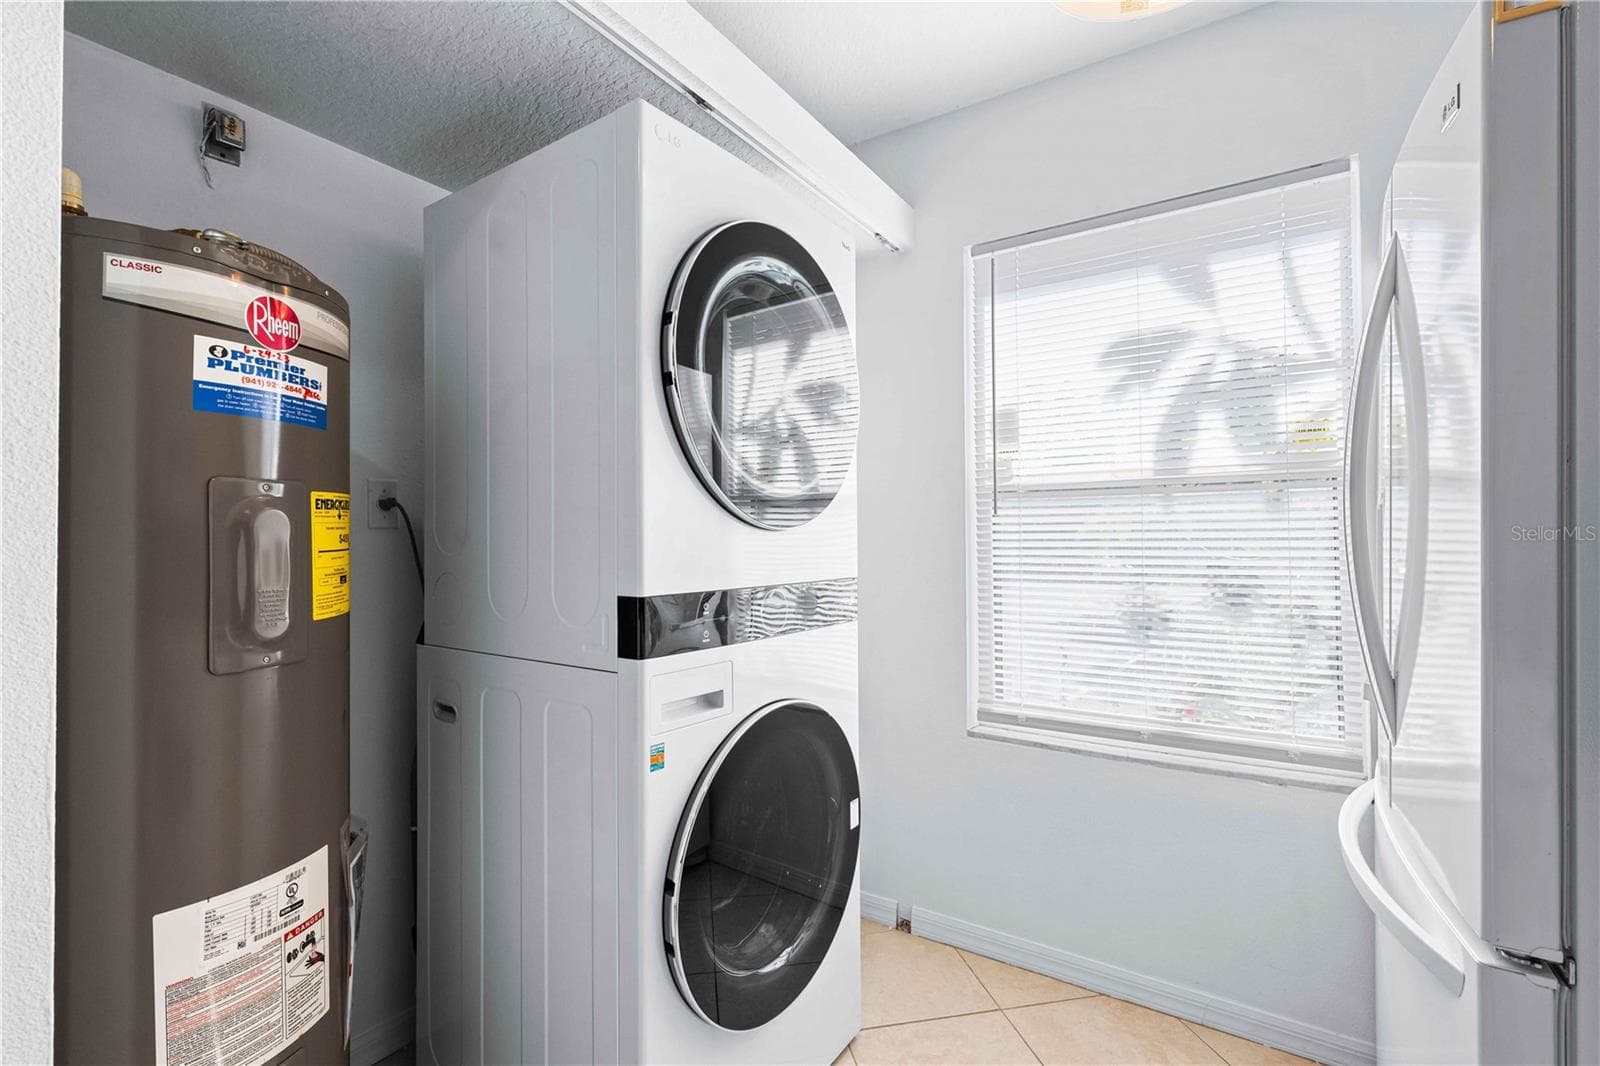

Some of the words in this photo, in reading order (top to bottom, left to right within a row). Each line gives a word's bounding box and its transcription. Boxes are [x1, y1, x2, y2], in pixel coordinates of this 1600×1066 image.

[110, 258, 163, 274] CLASSIC
[252, 296, 299, 342] Rheem
[207, 357, 318, 391] PLUMBERS
[230, 350, 306, 376] Premier
[198, 383, 231, 393] Emergency
[241, 376, 265, 388] (941)
[266, 380, 303, 395] 92-4846
[295, 909, 325, 936] DANGER
